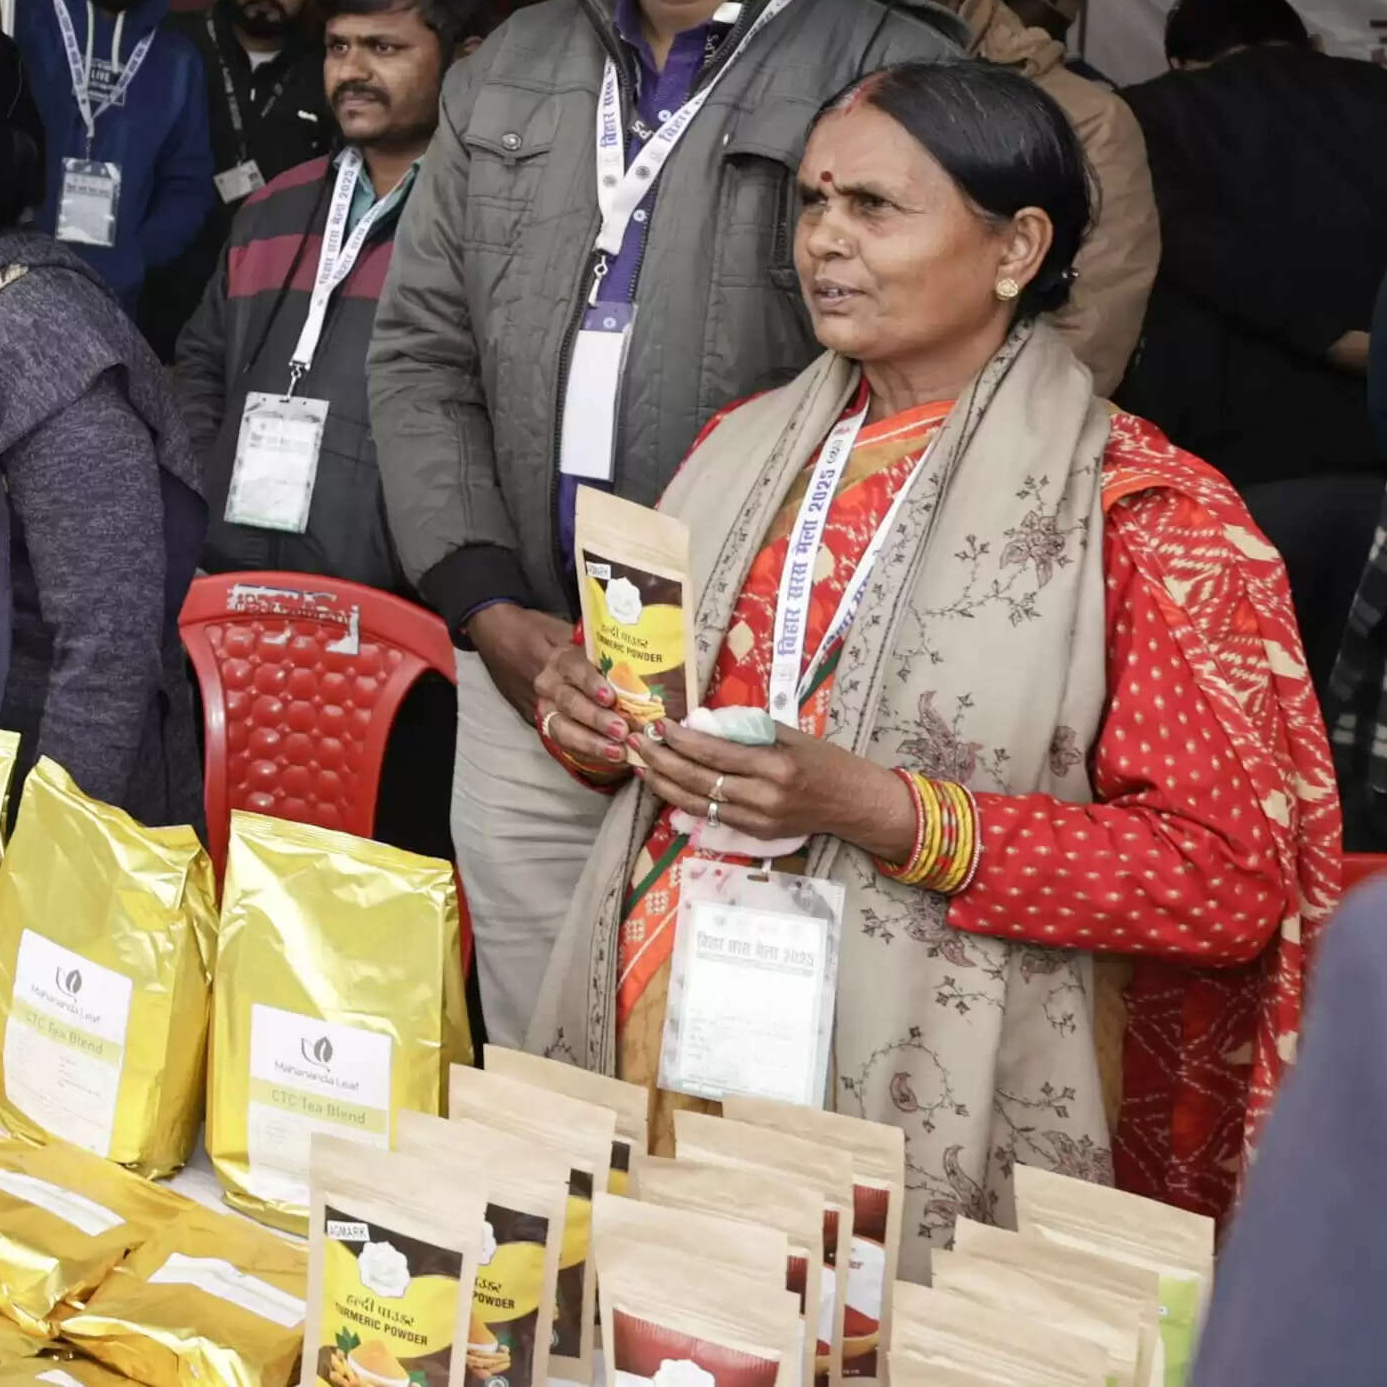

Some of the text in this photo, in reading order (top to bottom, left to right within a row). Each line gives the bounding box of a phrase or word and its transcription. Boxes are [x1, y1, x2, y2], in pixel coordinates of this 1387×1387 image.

[778, 468, 836, 657] बिहार सरस मेला 2025
[69, 1030, 104, 1055] Blend
[274, 1059, 335, 1086] Mahananda
[271, 1088, 366, 1126] CTC Tea Blend
[473, 1292, 516, 1310] POWDER
[383, 1323, 428, 1346] POWDER
